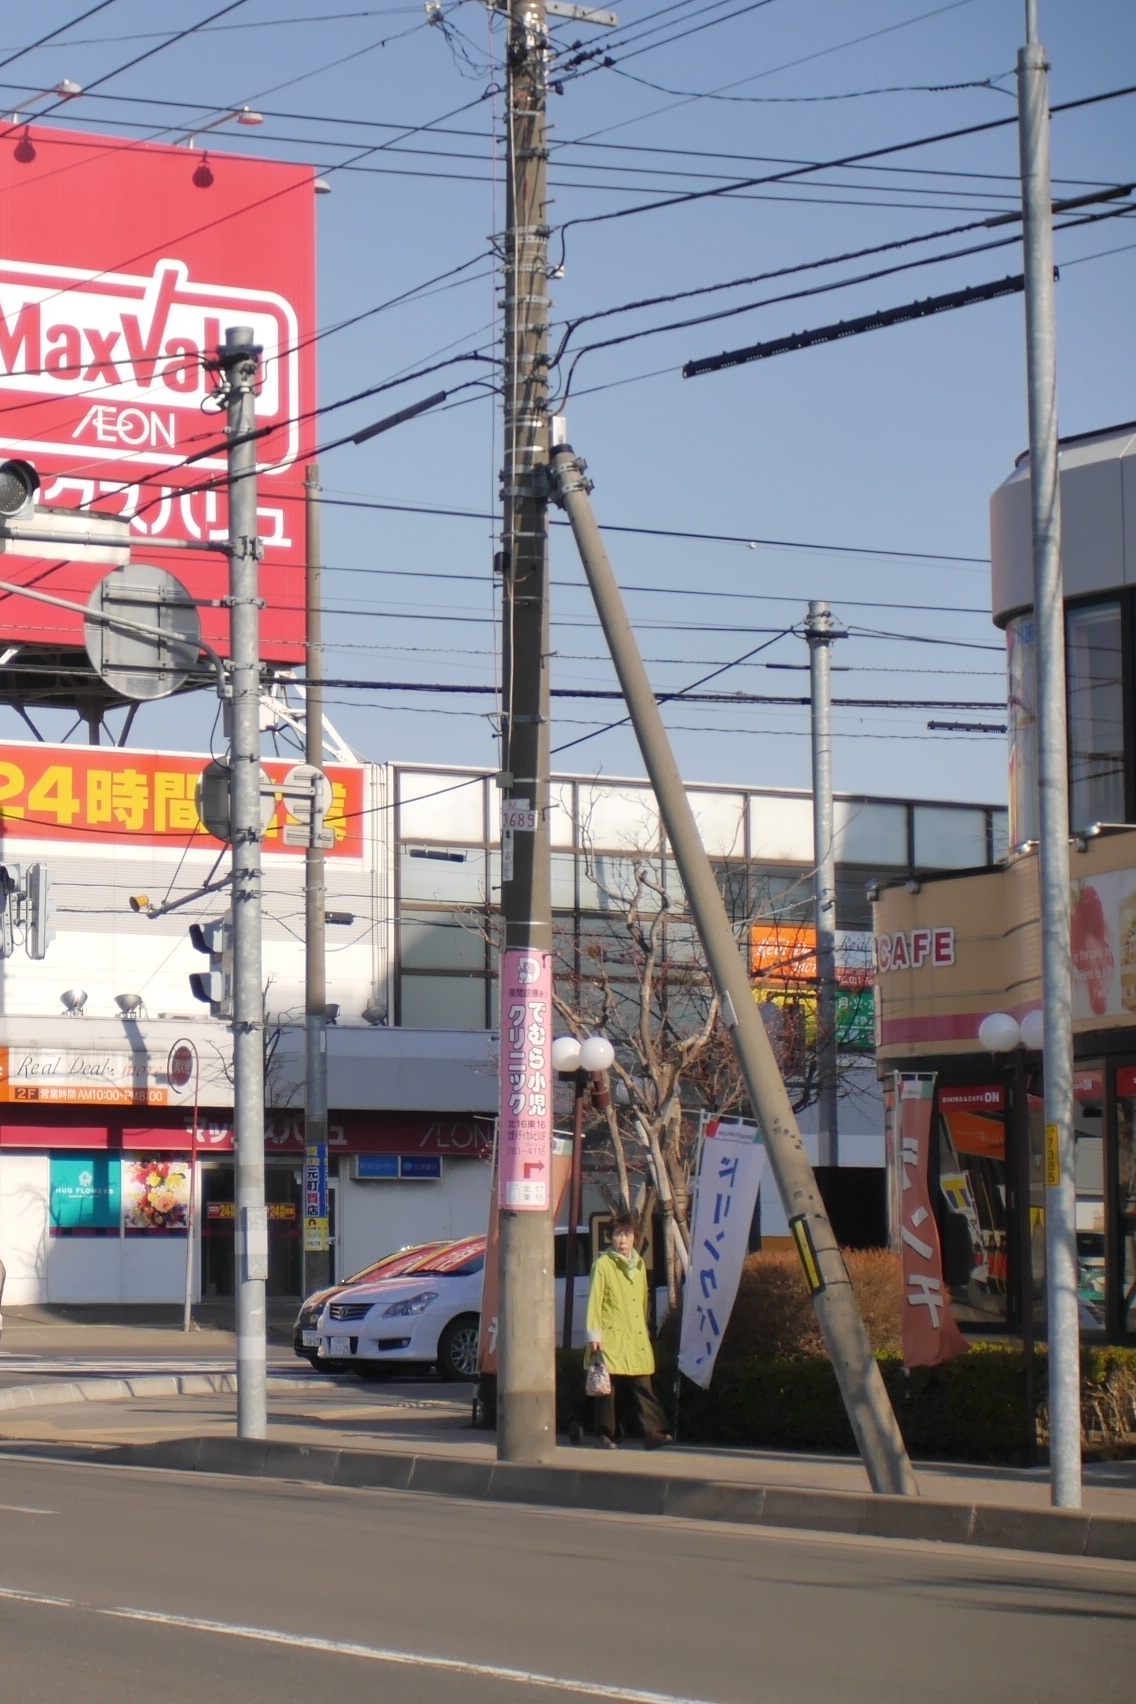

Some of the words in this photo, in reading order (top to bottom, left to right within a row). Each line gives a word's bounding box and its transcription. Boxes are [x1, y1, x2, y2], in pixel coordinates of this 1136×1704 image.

[877, 928, 954, 972] CAFE
[122, 1064, 163, 1077] more
[508, 1005, 526, 1116] クリニック
[528, 1001, 546, 1116] でむら小児
[17, 1089, 36, 1099] 2F
[40, 1088, 76, 1100] 営業時間
[984, 1091, 1000, 1103] ON
[1047, 1136, 1056, 1183] 7385
